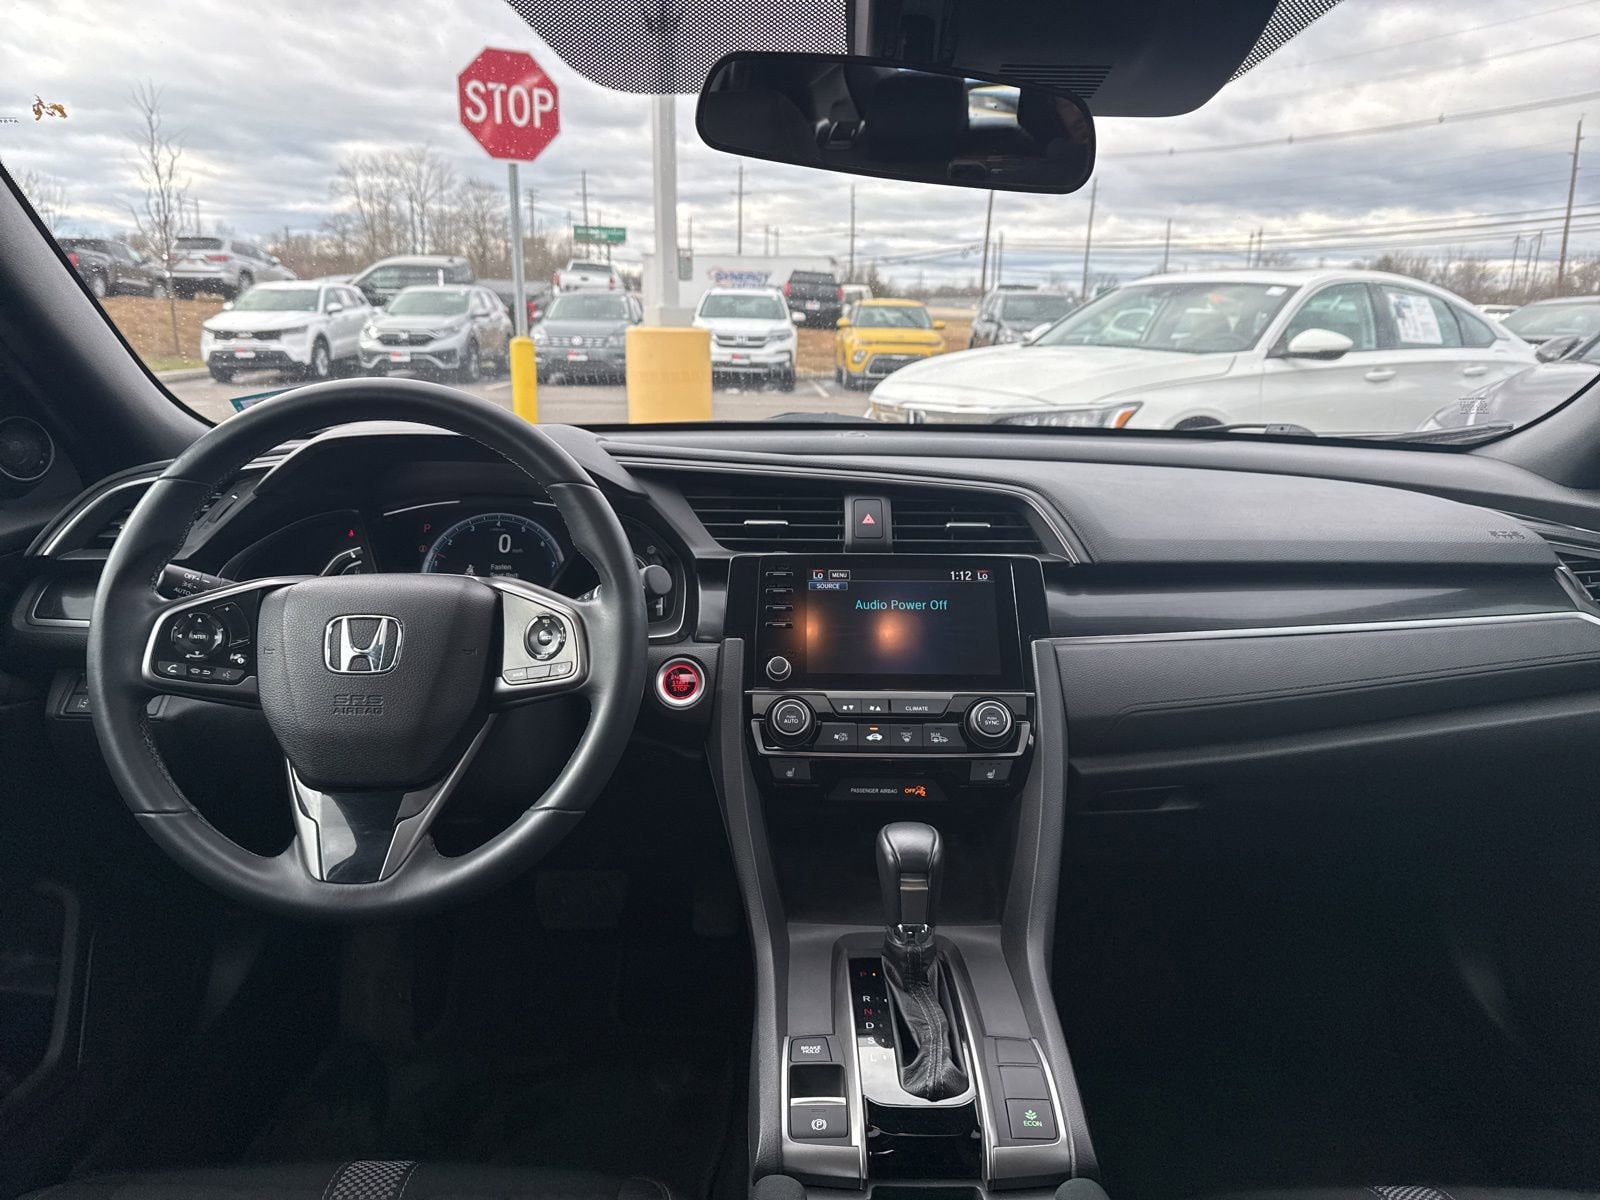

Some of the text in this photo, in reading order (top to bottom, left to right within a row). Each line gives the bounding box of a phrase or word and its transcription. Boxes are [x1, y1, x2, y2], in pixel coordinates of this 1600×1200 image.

[465, 79, 554, 128] STOP
[423, 523, 432, 533] P
[498, 533, 512, 554] 0
[490, 563, 512, 571] Fasten
[184, 572, 196, 580] OFF
[812, 571, 824, 580] Lo
[950, 571, 972, 581] 1:12
[977, 571, 988, 580] Lo
[173, 587, 191, 596] AUTO
[855, 599, 948, 610] Audio Power Off
[334, 694, 384, 706] SRS
[333, 706, 384, 716] AIRBAG
[867, 1036, 875, 1045] S
[870, 1053, 877, 1062] L
